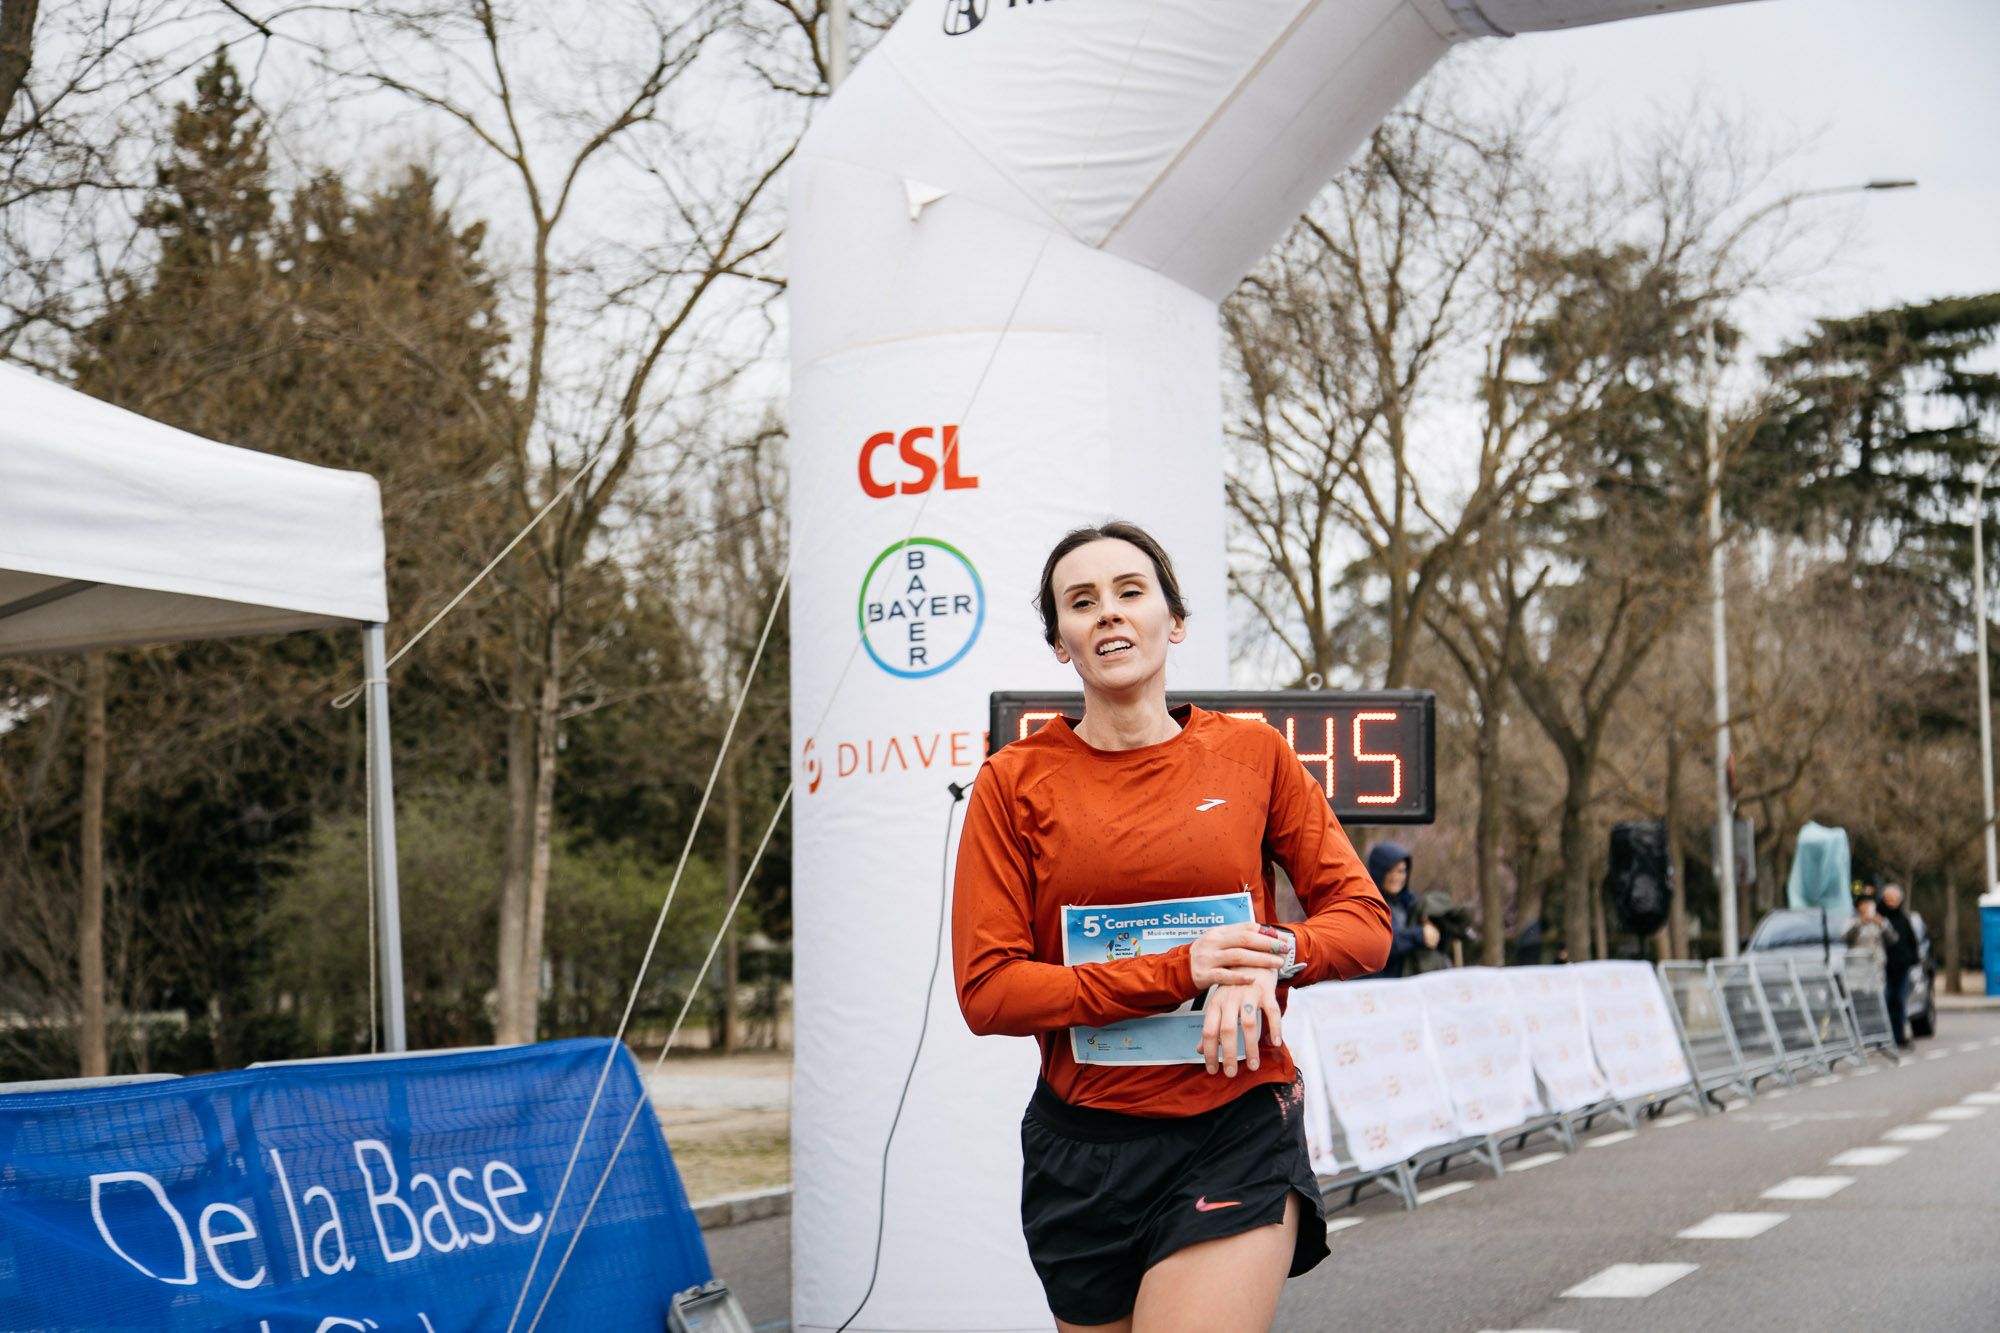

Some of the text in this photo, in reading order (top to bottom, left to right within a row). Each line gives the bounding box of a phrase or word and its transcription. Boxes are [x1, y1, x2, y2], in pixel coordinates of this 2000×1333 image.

[858, 425, 979, 499] CSL
[868, 595, 973, 623] BAYER
[906, 551, 929, 667] BAYER
[838, 729, 990, 778] DIAVE
[1104, 916, 1159, 930] Carrera
[1163, 912, 1224, 925] Solidaria
[90, 1139, 544, 1289] De la Base
